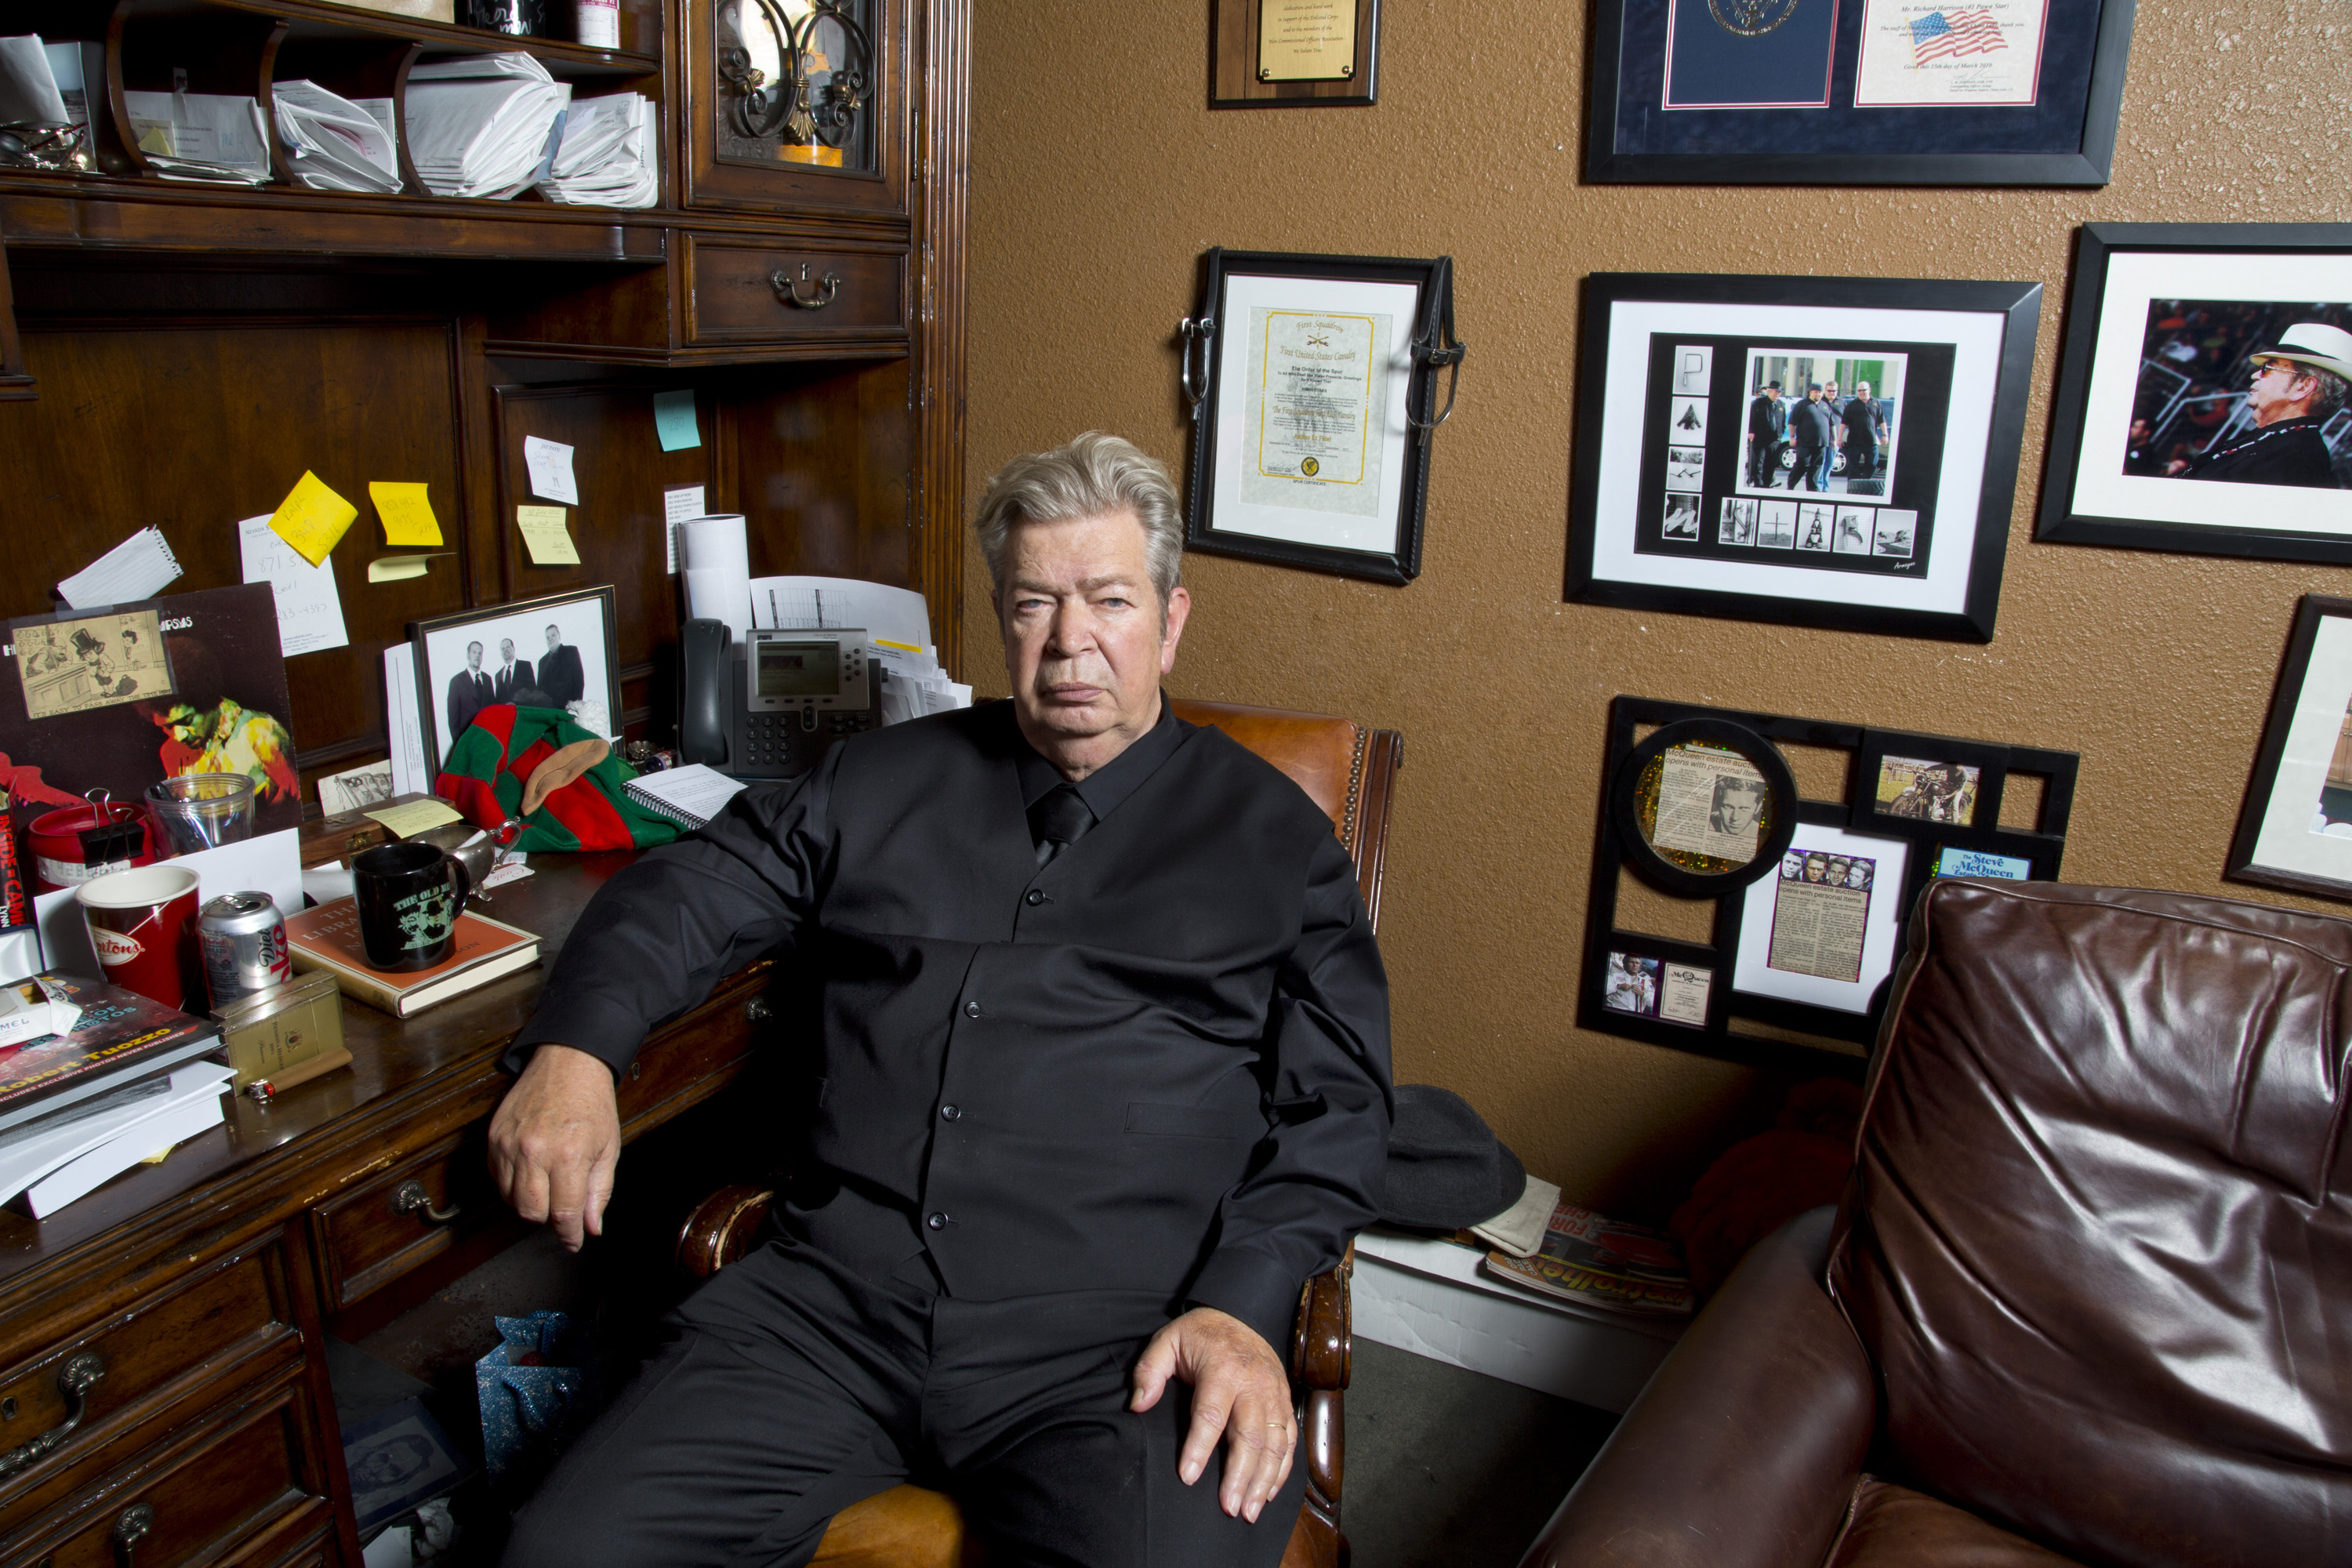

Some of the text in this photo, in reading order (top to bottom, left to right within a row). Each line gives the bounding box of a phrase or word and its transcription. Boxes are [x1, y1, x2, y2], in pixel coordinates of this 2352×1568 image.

[1297, 320, 1344, 333] First Squadron
[1280, 345, 1356, 362] First United States Cavalry
[49, 706, 69, 717] EASY
[106, 697, 125, 706] AWAY
[1666, 749, 1705, 760] McQueen
[1706, 756, 1731, 765] estate
[1665, 757, 1763, 779] opens with personal items
[1971, 853, 2005, 867] Steve
[1951, 861, 2014, 878] McQueen
[1780, 880, 1860, 896] McQueen estate auction
[393, 886, 440, 912] THE OLD
[1814, 892, 1842, 901] personal
[1843, 895, 1861, 903] items
[0, 906, 10, 928] LYNN
[301, 917, 359, 941] LIBRA
[258, 929, 275, 967] Diet
[1668, 971, 1709, 983] McQueen
[72, 1006, 137, 1033] HOTOS
[94, 1005, 118, 1016] OF
[0, 1027, 172, 1096] Robert Tuozzo
[38, 1069, 83, 1088] EXCLUSIVE
[84, 1057, 117, 1071] PHOTOS
[117, 1046, 144, 1058] NEVER
[142, 1031, 186, 1051] PUBLISHED
